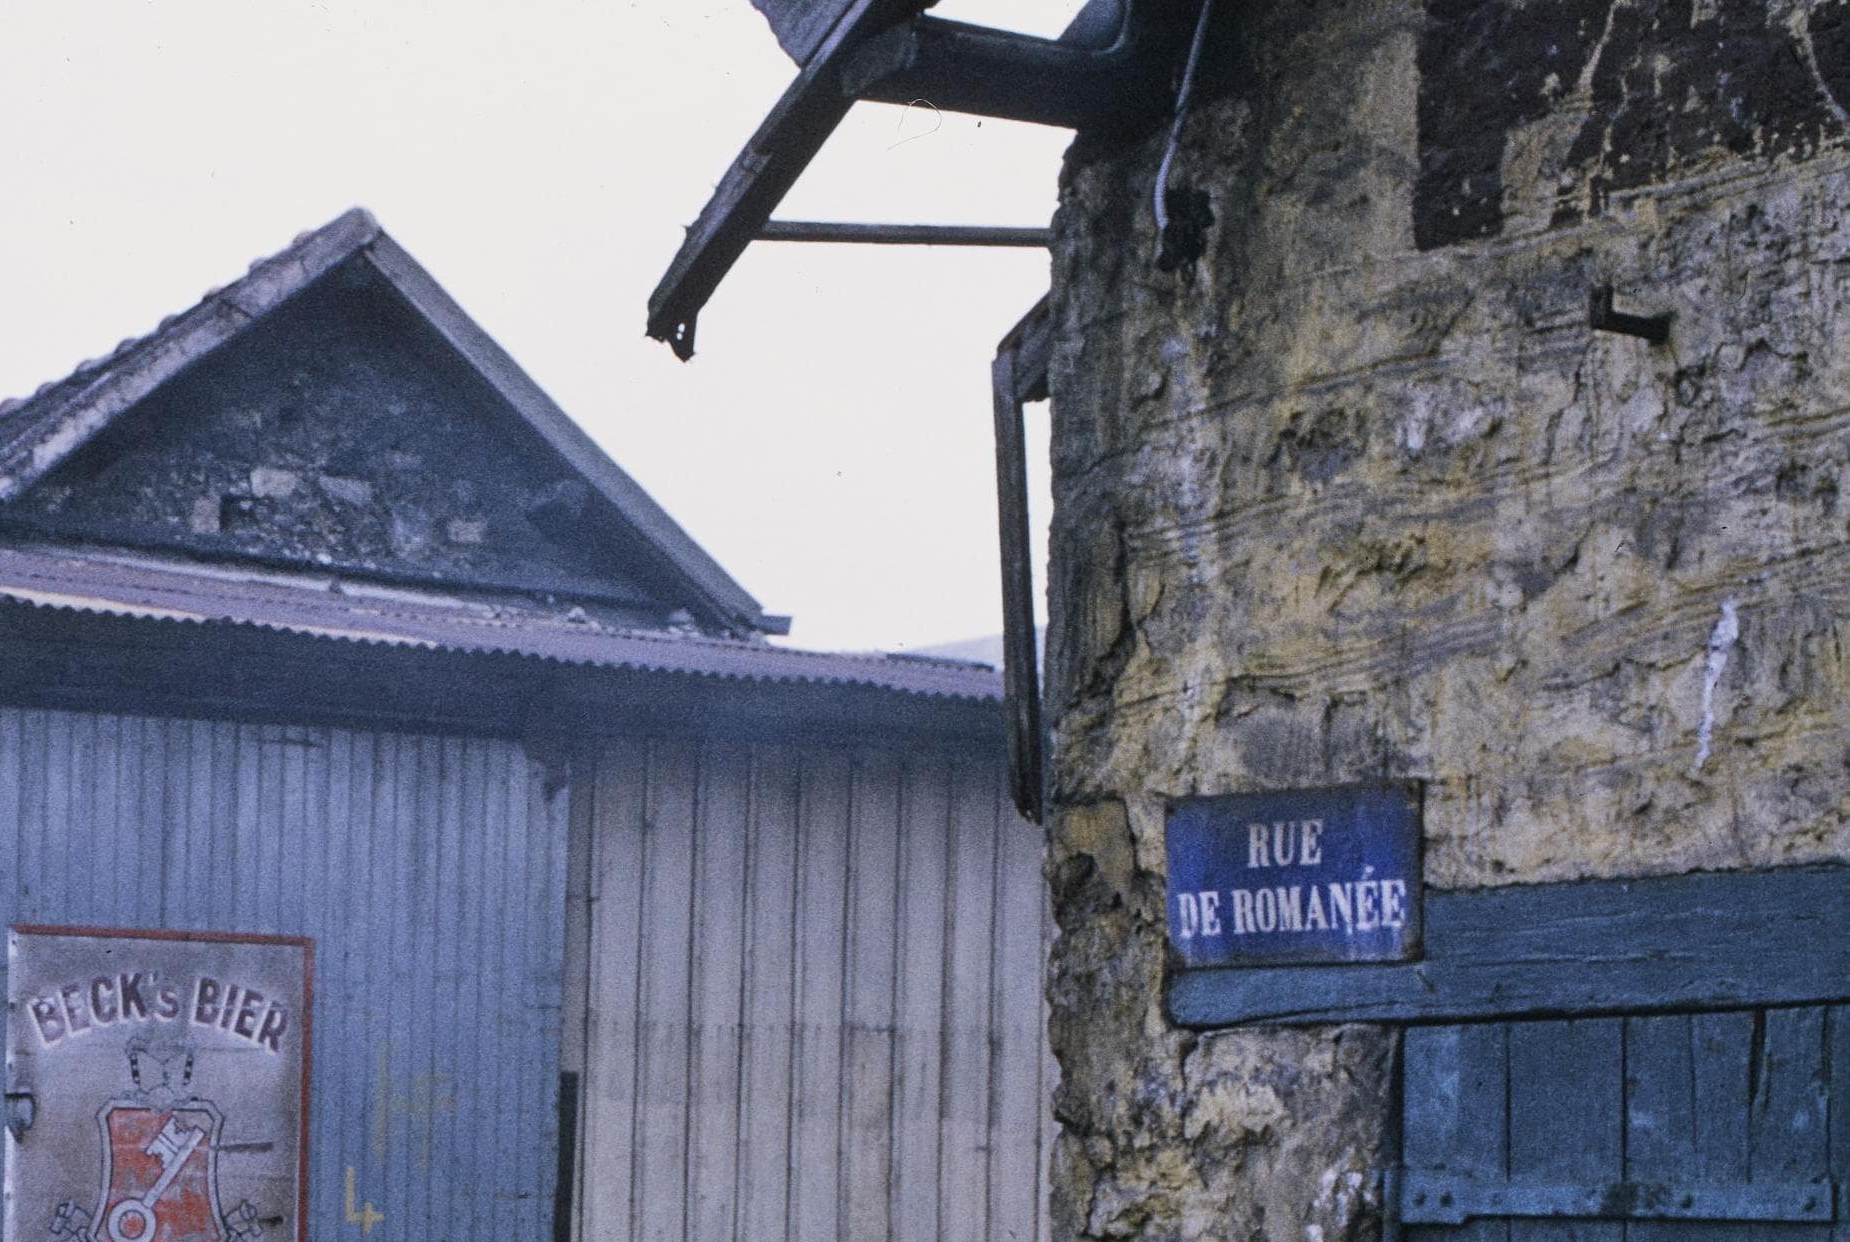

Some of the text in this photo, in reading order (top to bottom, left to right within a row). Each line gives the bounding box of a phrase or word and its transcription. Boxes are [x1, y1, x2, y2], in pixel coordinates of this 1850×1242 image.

[1247, 818, 1324, 868] RUE
[1176, 865, 1407, 939] DE ROMANÉE
[190, 976, 289, 1056] BIER
